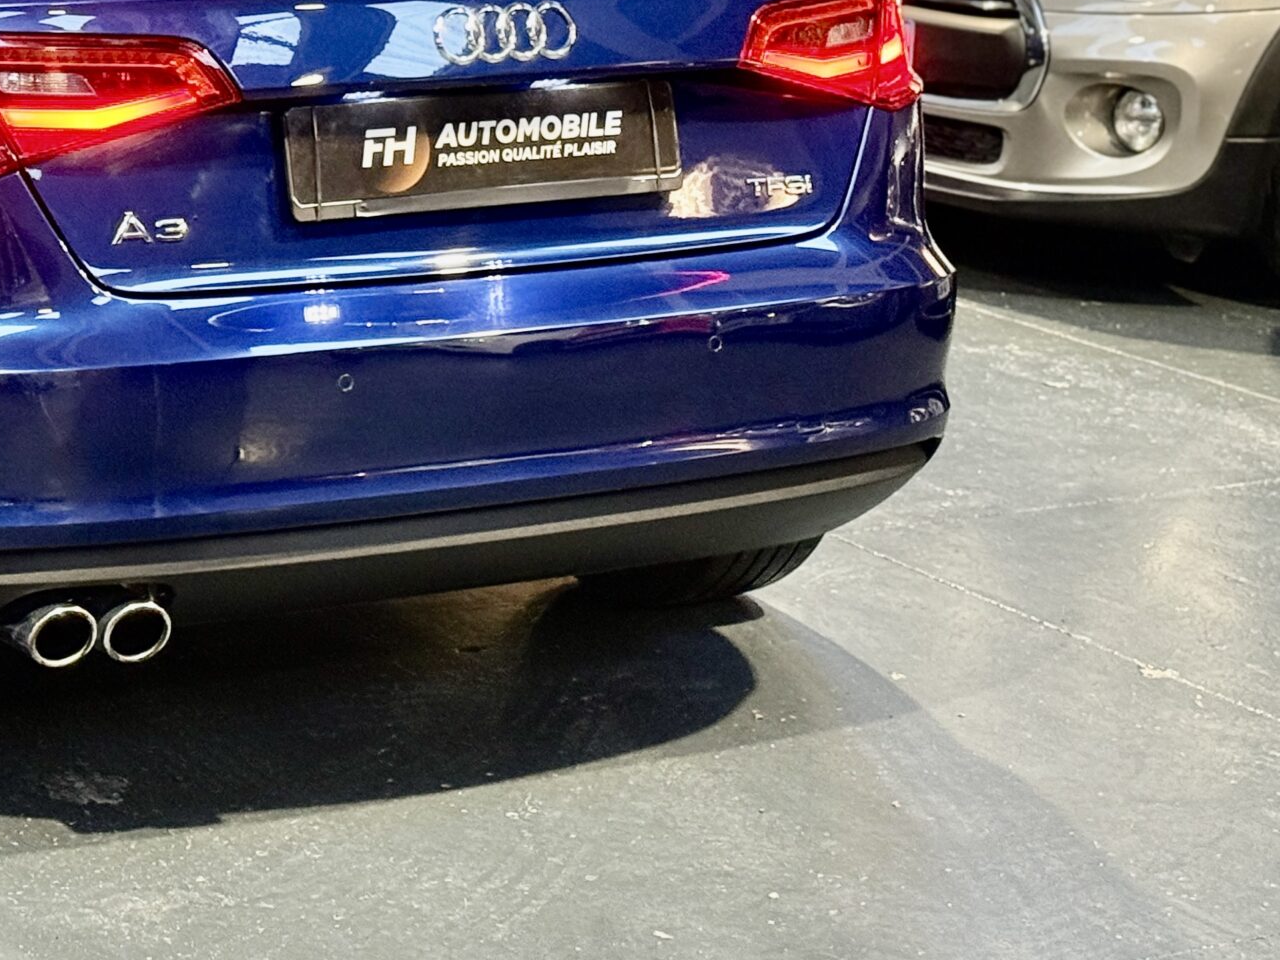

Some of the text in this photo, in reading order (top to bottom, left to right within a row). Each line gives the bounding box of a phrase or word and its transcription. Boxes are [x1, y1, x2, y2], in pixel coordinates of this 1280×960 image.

[362, 110, 623, 168] FH AUTOMOBILE
[437, 140, 617, 167] PASSION QUALITÉ PLAISIR
[745, 173, 813, 197] TFSI
[111, 211, 189, 245] A3
